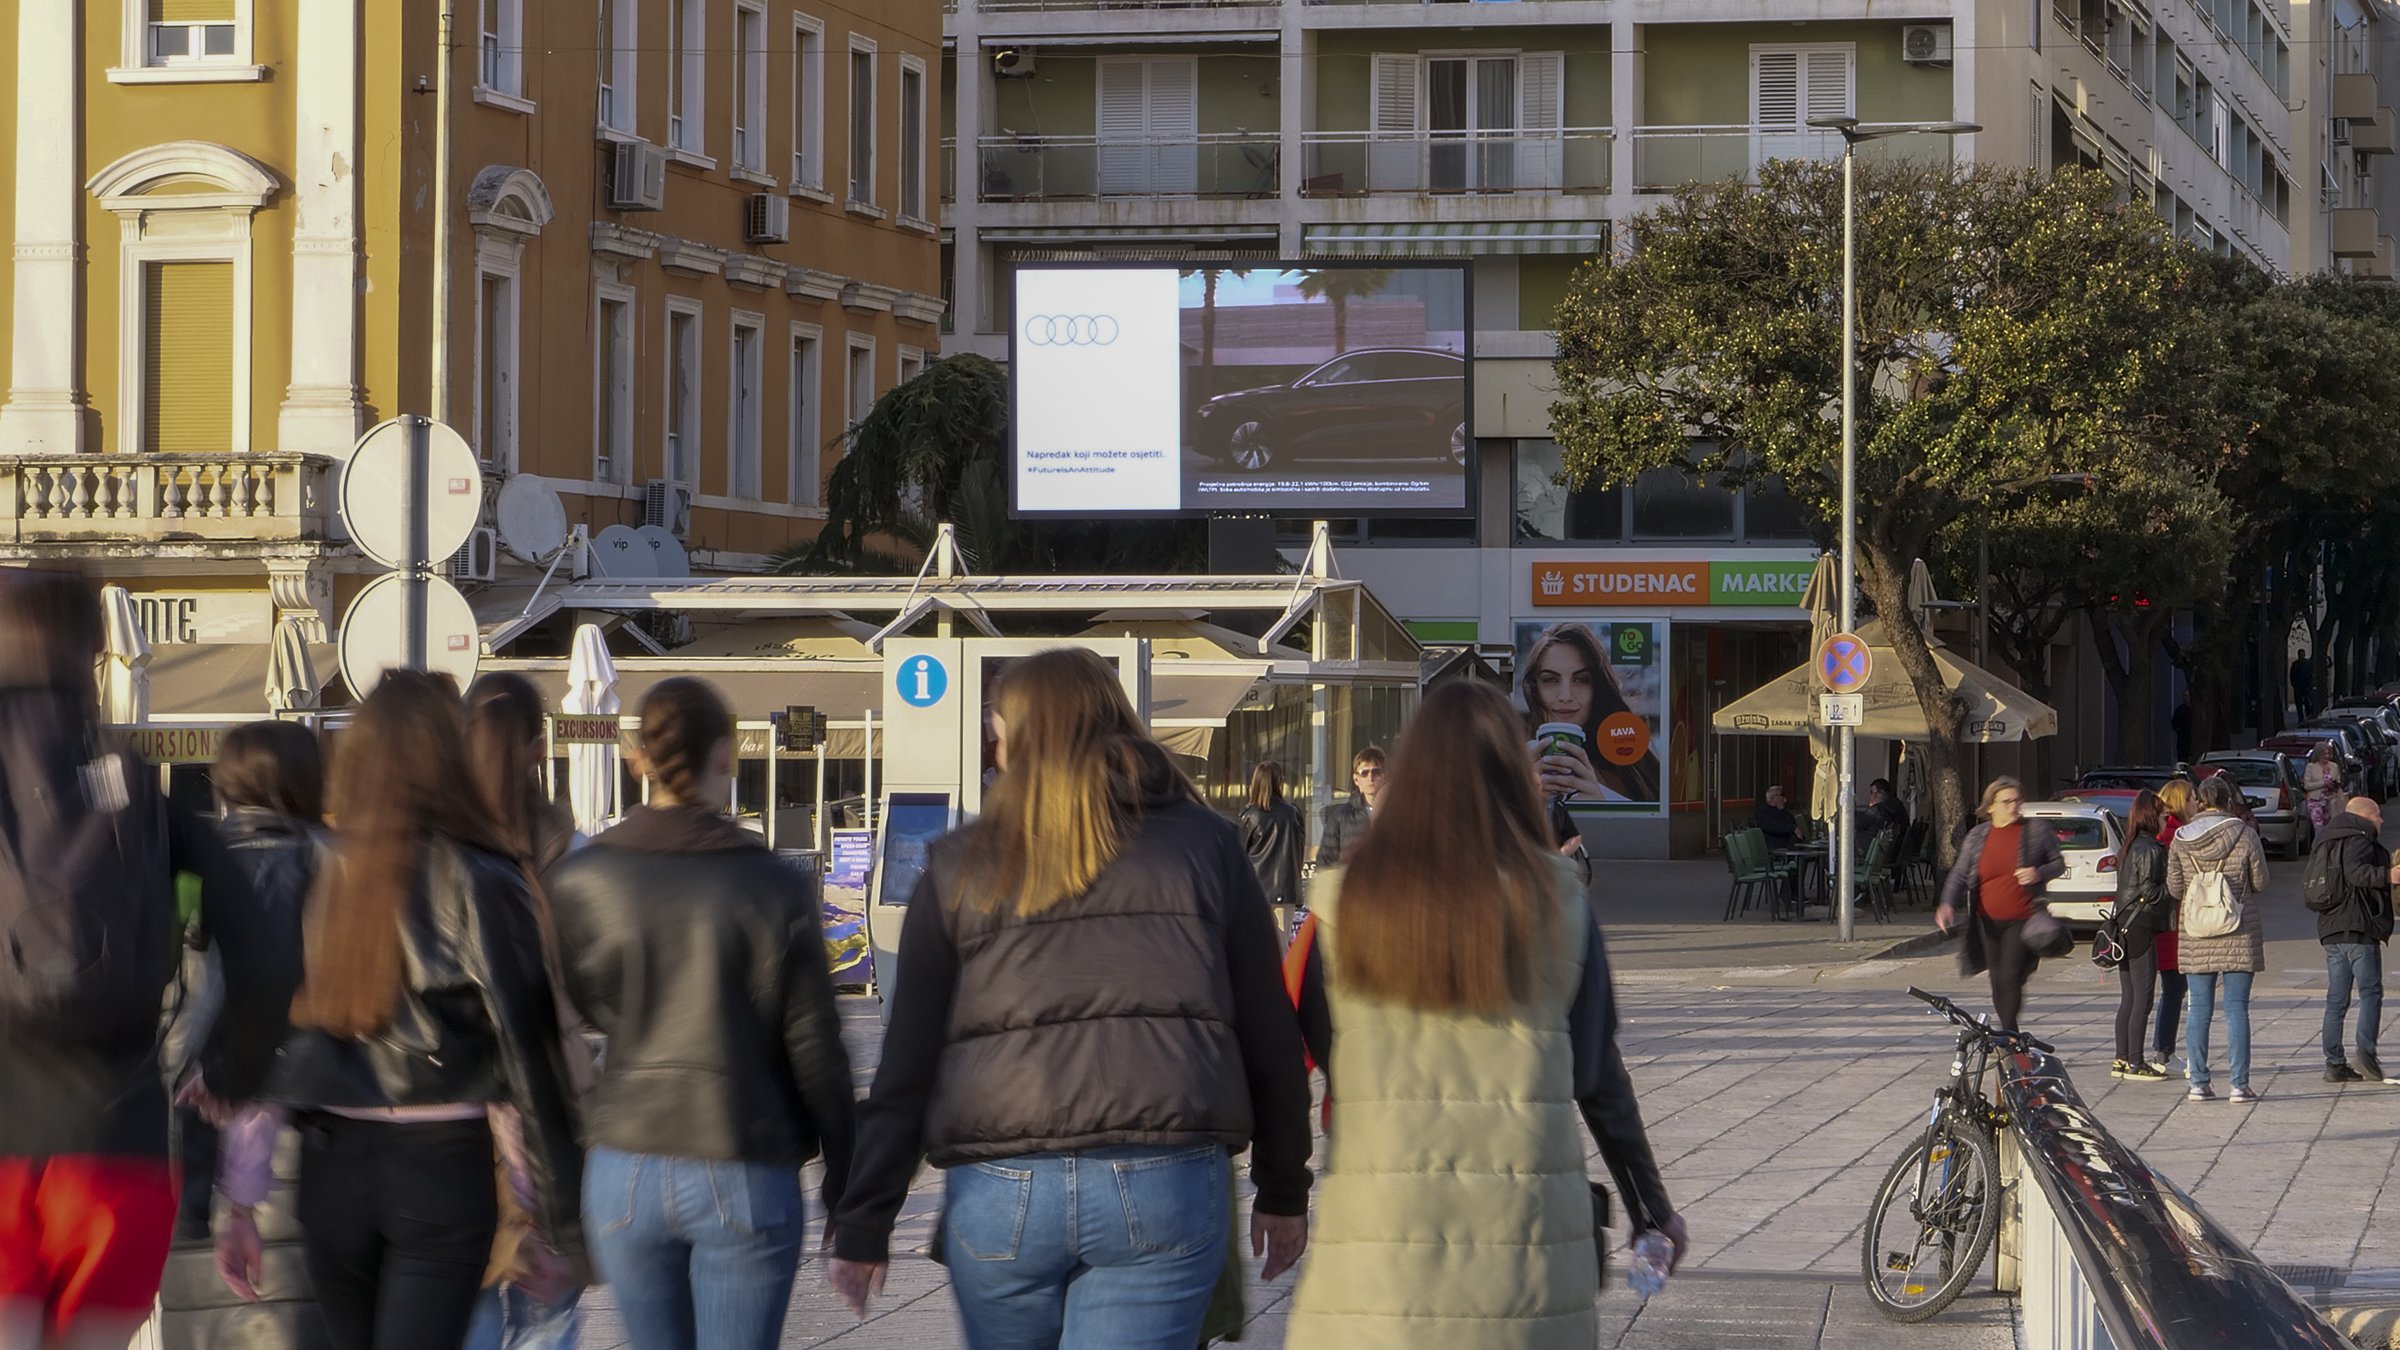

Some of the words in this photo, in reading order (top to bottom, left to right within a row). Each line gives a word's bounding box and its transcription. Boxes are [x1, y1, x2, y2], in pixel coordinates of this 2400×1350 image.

[1027, 451, 1071, 460] Napredak
[1074, 451, 1090, 460] koji
[1093, 450, 1127, 458] možete
[612, 537, 629, 551] vip
[1573, 573, 1696, 593] STUDENAC
[1722, 573, 1811, 593] MARKE
[133, 598, 197, 644] NTE
[557, 719, 618, 739] EXCURSIONS
[1610, 727, 1636, 737] KAVA
[740, 736, 765, 752] bar
